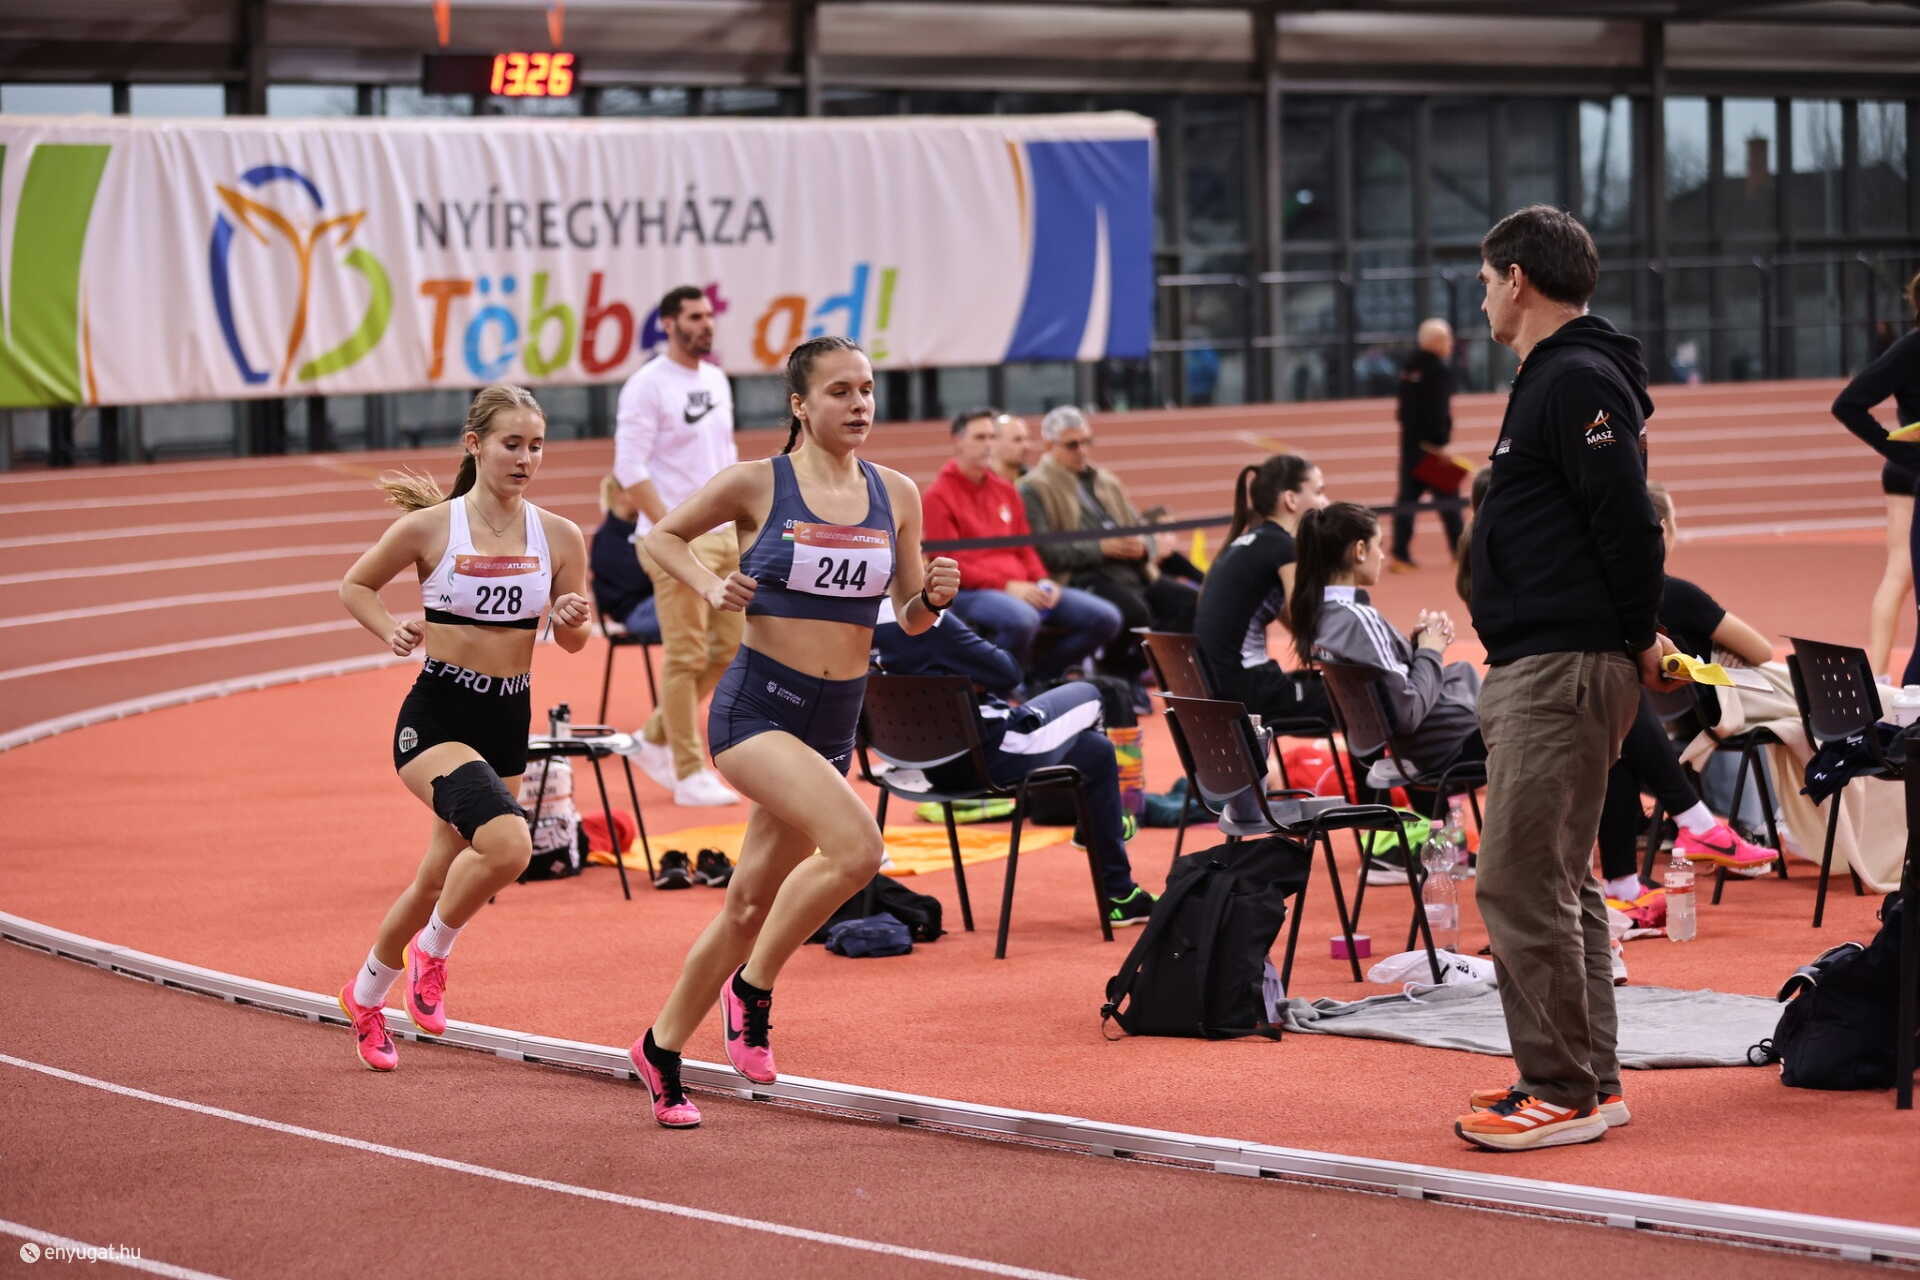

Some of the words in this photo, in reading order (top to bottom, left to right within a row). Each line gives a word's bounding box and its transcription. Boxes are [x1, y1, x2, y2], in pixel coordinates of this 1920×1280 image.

[414, 182, 775, 249] NYÍREGYHÁZA
[1586, 430, 1614, 445] MASZ
[814, 557, 868, 591] 244
[475, 586, 523, 615] 228
[438, 663, 492, 693] PRO
